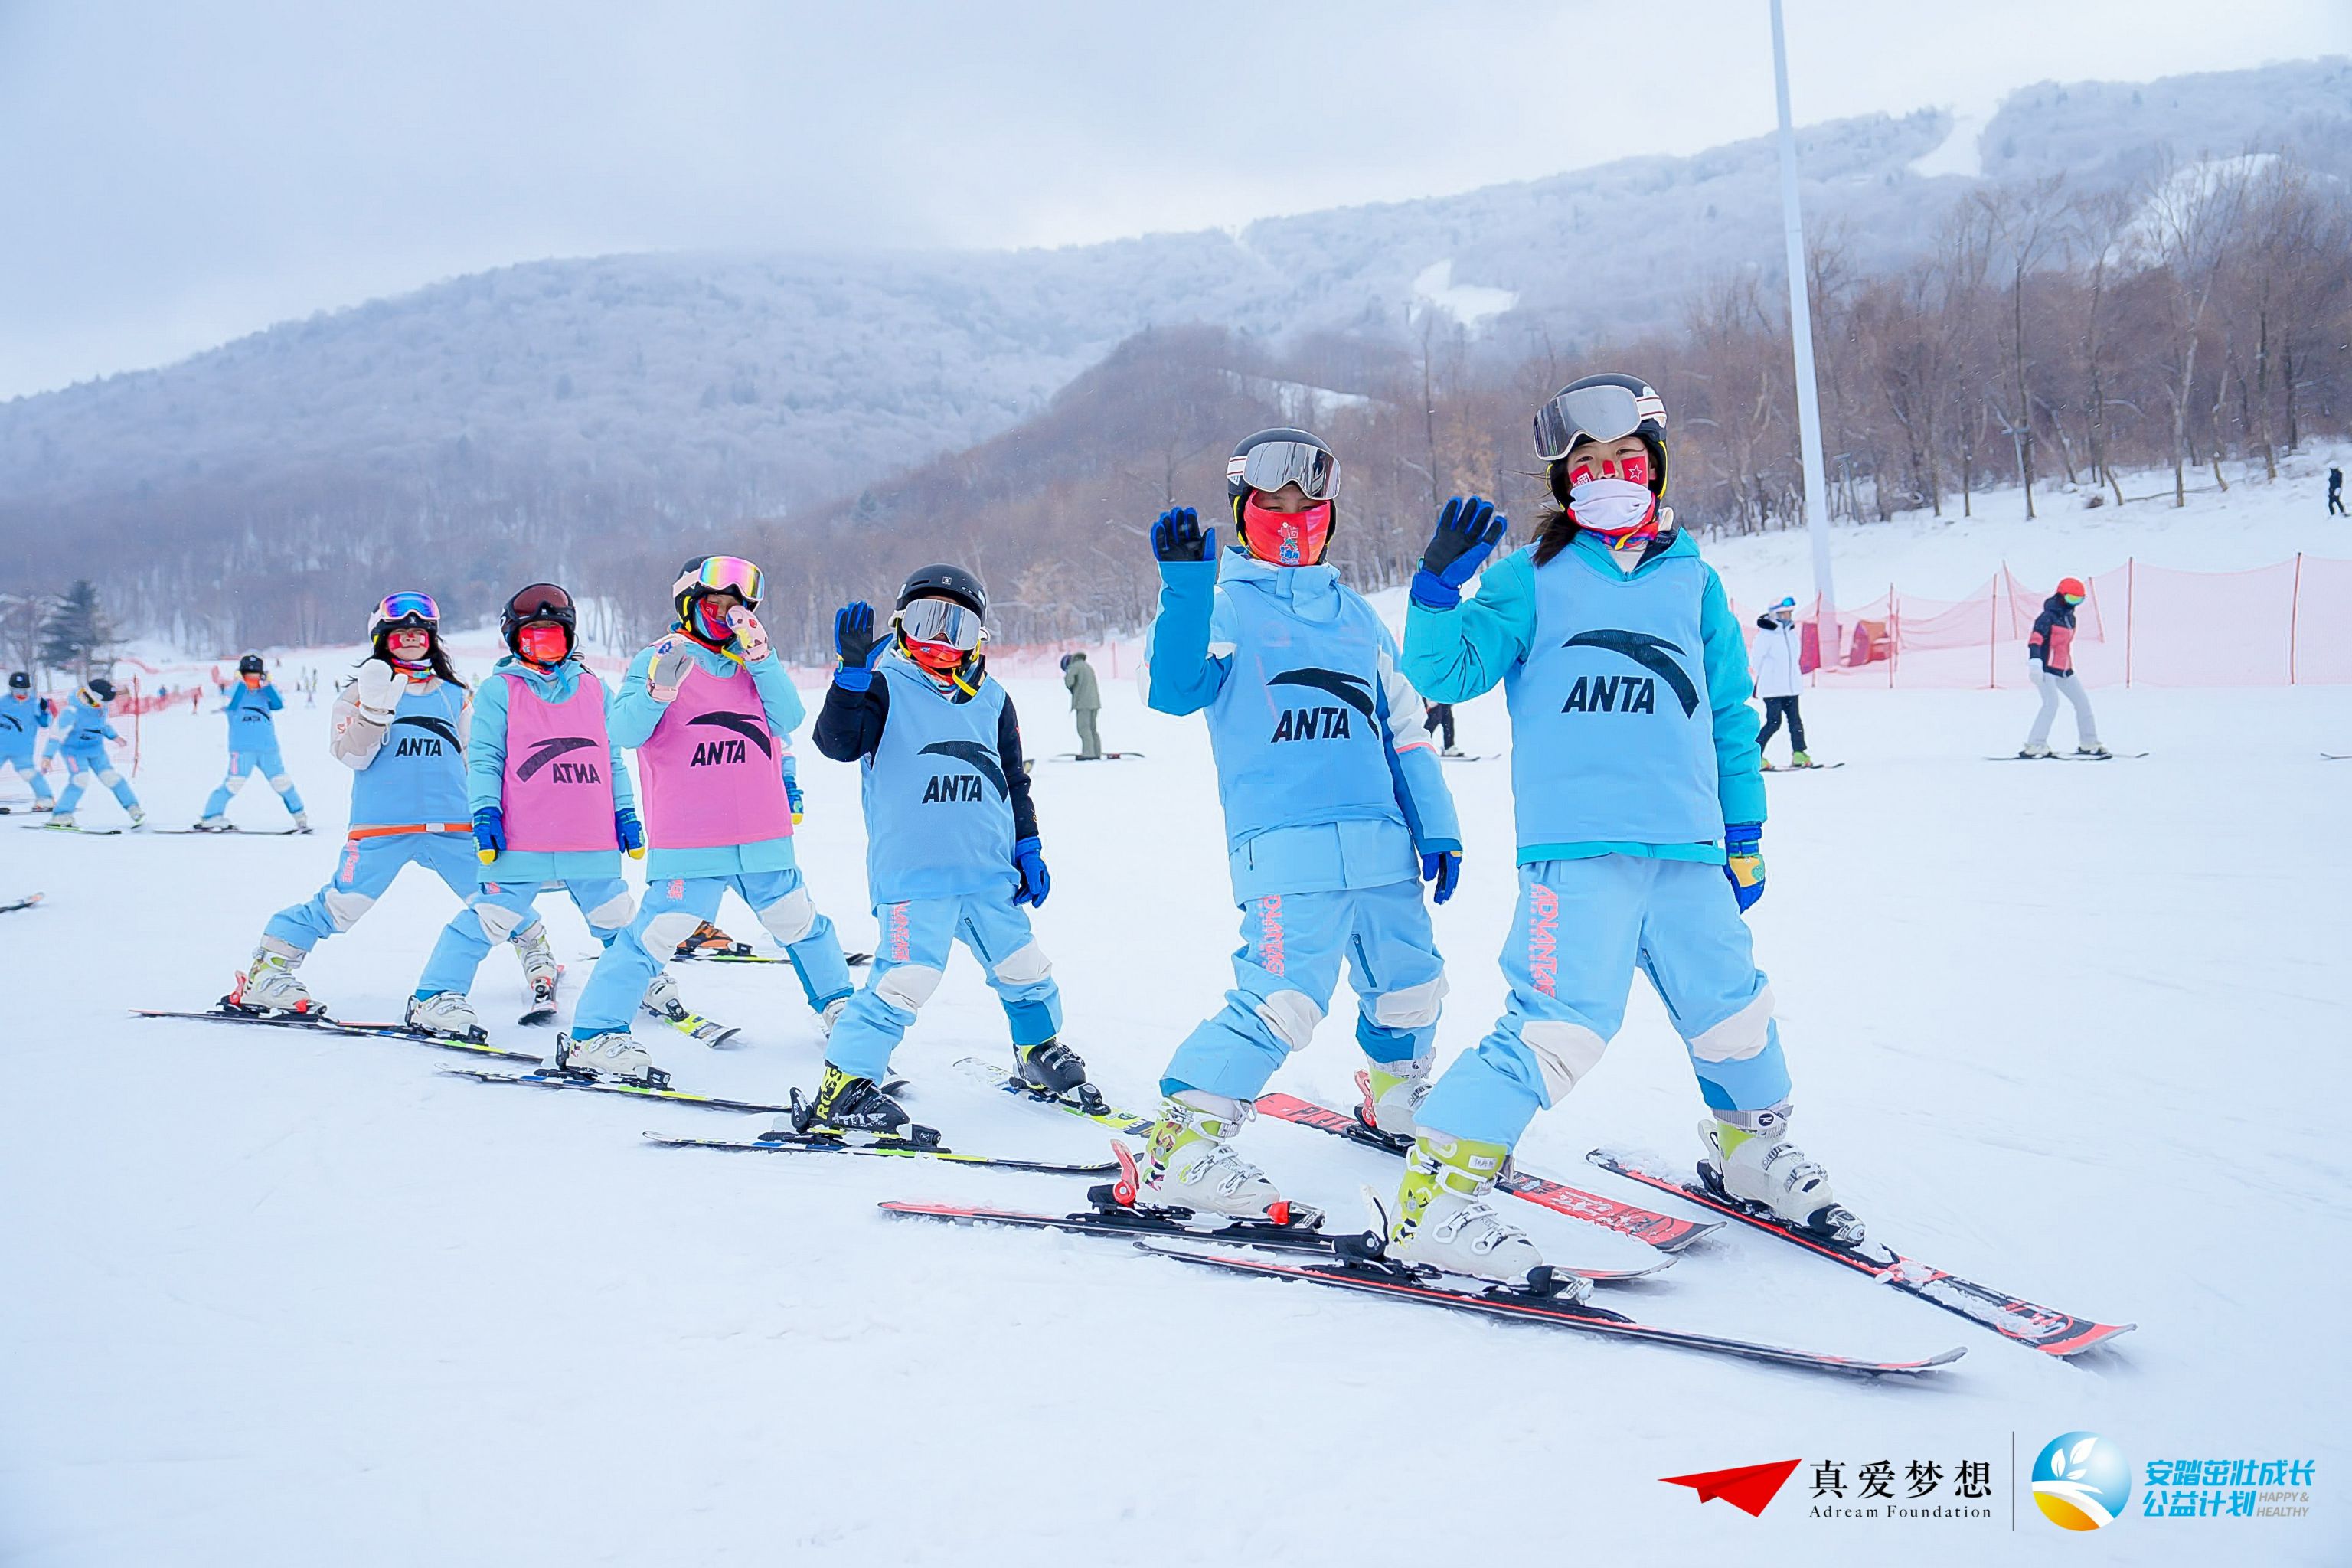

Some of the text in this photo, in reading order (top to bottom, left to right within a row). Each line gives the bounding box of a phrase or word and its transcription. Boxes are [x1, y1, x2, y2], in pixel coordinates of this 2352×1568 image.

[1561, 676, 1655, 714] ANTA
[1271, 707, 1351, 743] ANTA
[395, 737, 442, 757] ANTA
[690, 740, 746, 767] ANTA
[922, 775, 982, 804] ANTA
[1263, 895, 1285, 976] DVANTAG
